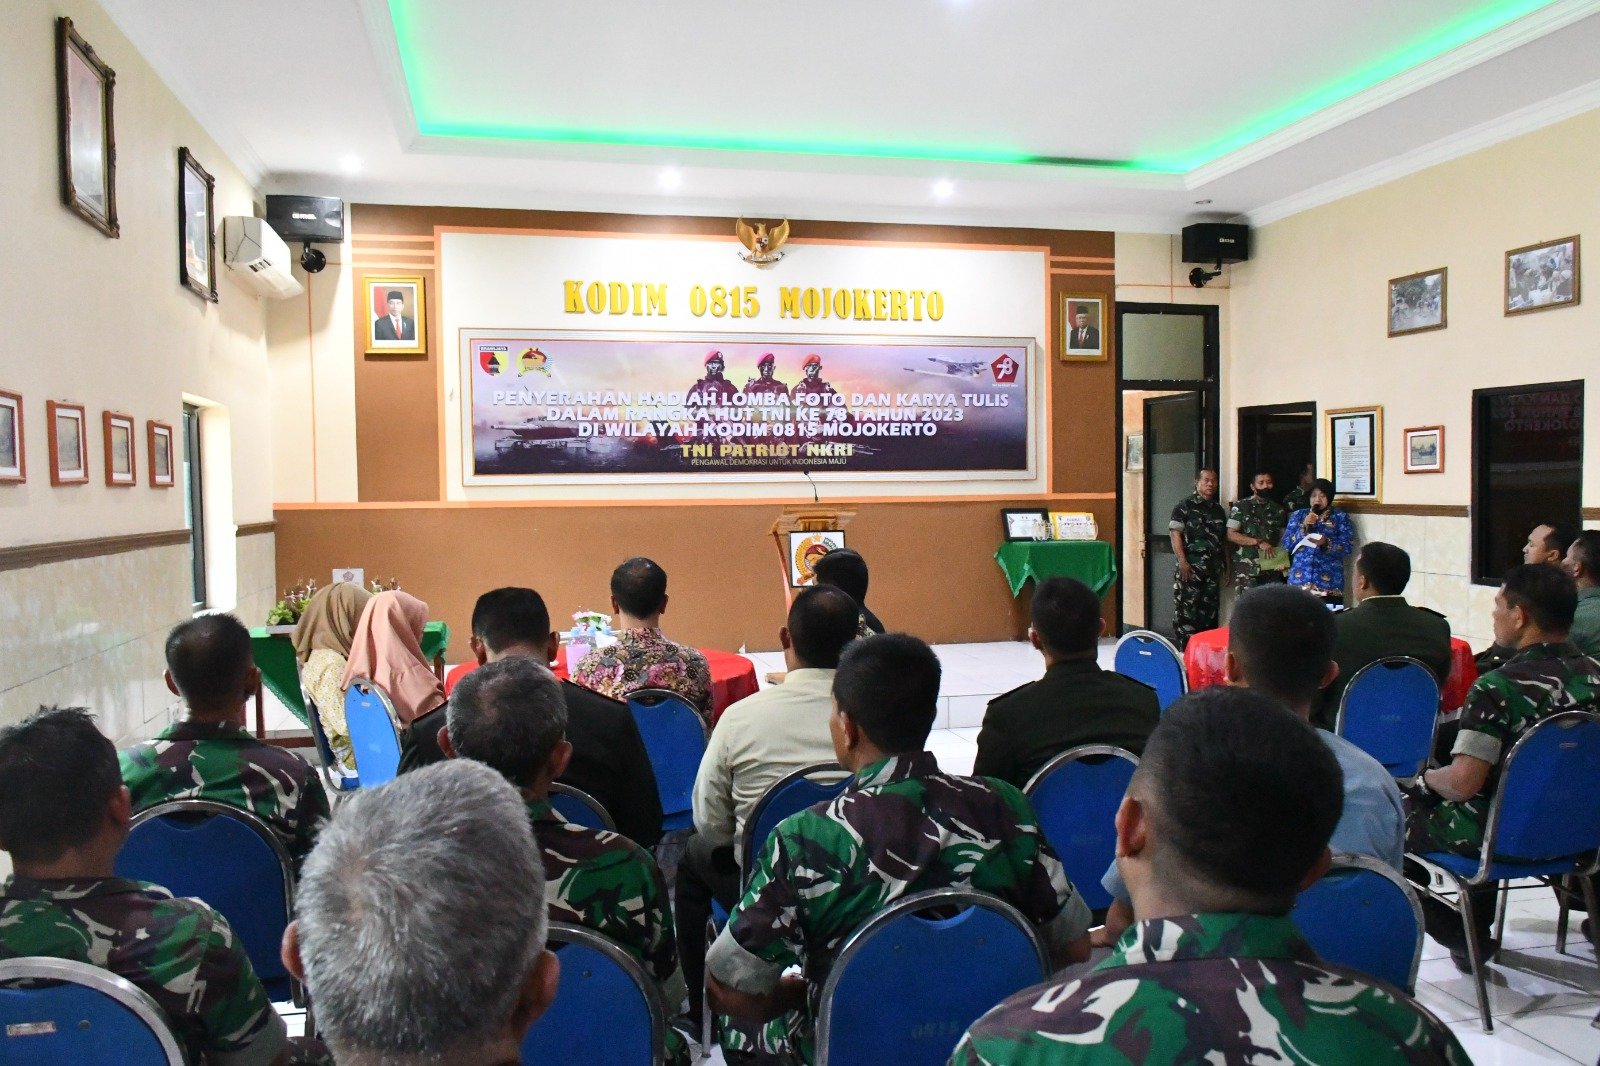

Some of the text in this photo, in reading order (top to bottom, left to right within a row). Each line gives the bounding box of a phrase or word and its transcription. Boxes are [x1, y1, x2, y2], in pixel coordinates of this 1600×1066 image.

[563, 279, 945, 321] KODIM 0815 MOJOKERTO
[493, 390, 1009, 407] PENYERAHAN HADIAH LOMBA FOTO DAN KARYA TULIS
[546, 406, 964, 422] DALAM RANGKA HUT TNI KE 78 TAHUN 2023
[578, 422, 937, 437] DI WILAYAH KODIM 0815 MOJOKERTO
[681, 443, 855, 458] TNI PATRIOT NKRI
[691, 458, 729, 466] PENGAWAL
[729, 458, 768, 466] DEMOKRASI
